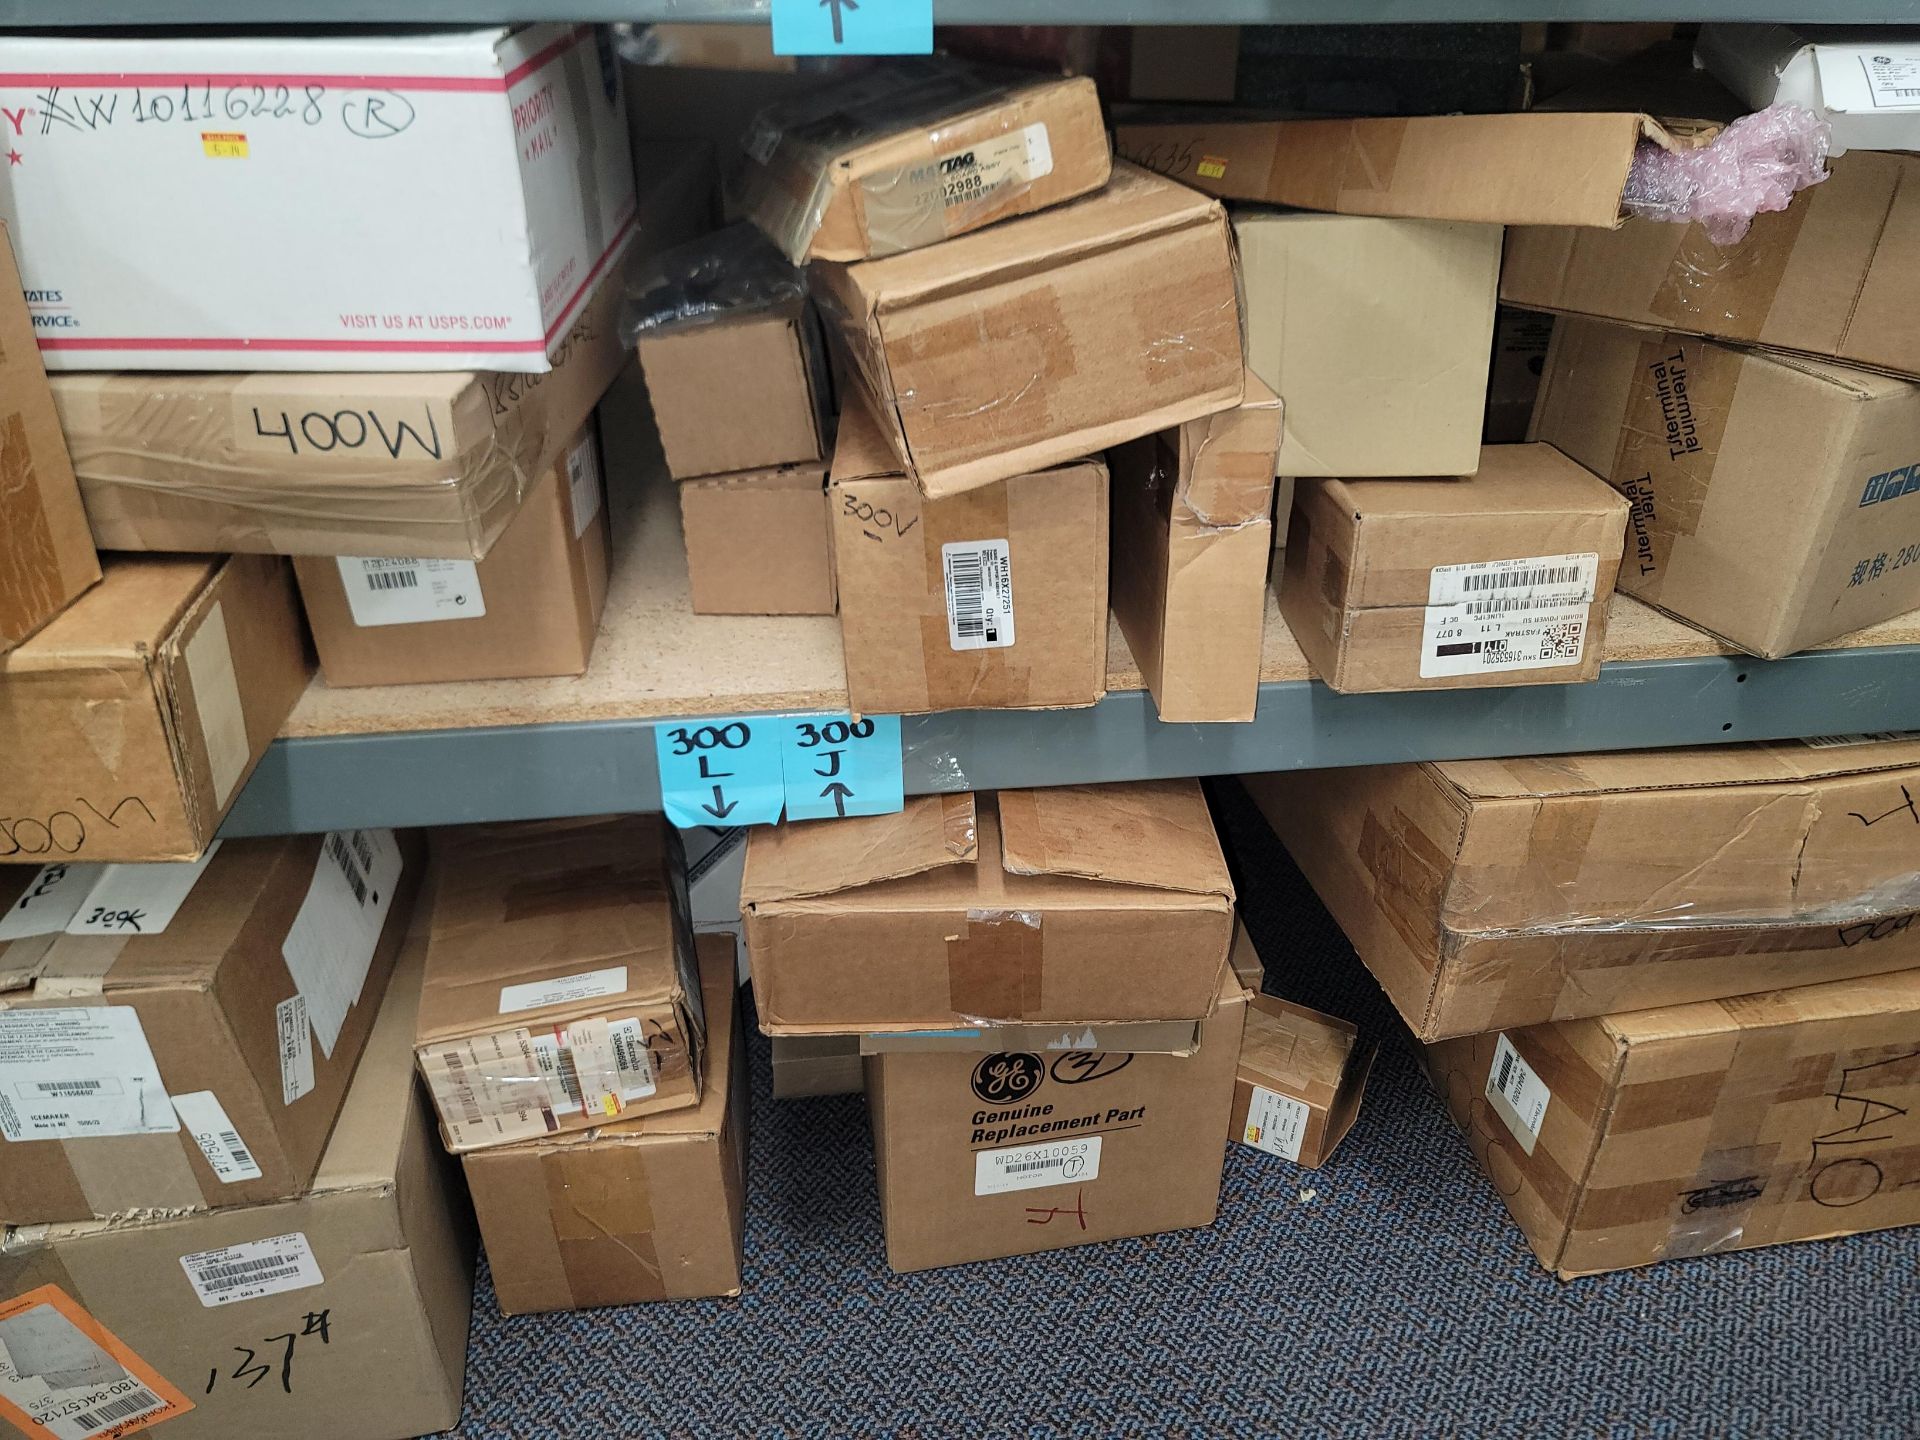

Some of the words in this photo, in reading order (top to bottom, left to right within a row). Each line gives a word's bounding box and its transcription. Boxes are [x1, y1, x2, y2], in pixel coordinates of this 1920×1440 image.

[340, 315, 378, 330] VISIT
[382, 316, 404, 330] US
[407, 316, 425, 330] AT
[253, 403, 442, 460] 400W
[843, 493, 919, 538] 300V
[1000, 556, 1012, 614] WH16X27251
[985, 608, 995, 626] Qty:
[1483, 650, 1523, 665] 316535201
[1485, 640, 1507, 653] QTY
[666, 722, 752, 756] 300
[795, 718, 875, 748] 300
[698, 755, 735, 778] L
[813, 750, 848, 776] J
[970, 1113, 1101, 1144] Replacement
[1104, 1106, 1146, 1124] Part
[971, 1104, 1054, 1126] Genuine
[995, 1144, 1088, 1166] WD26X10059
